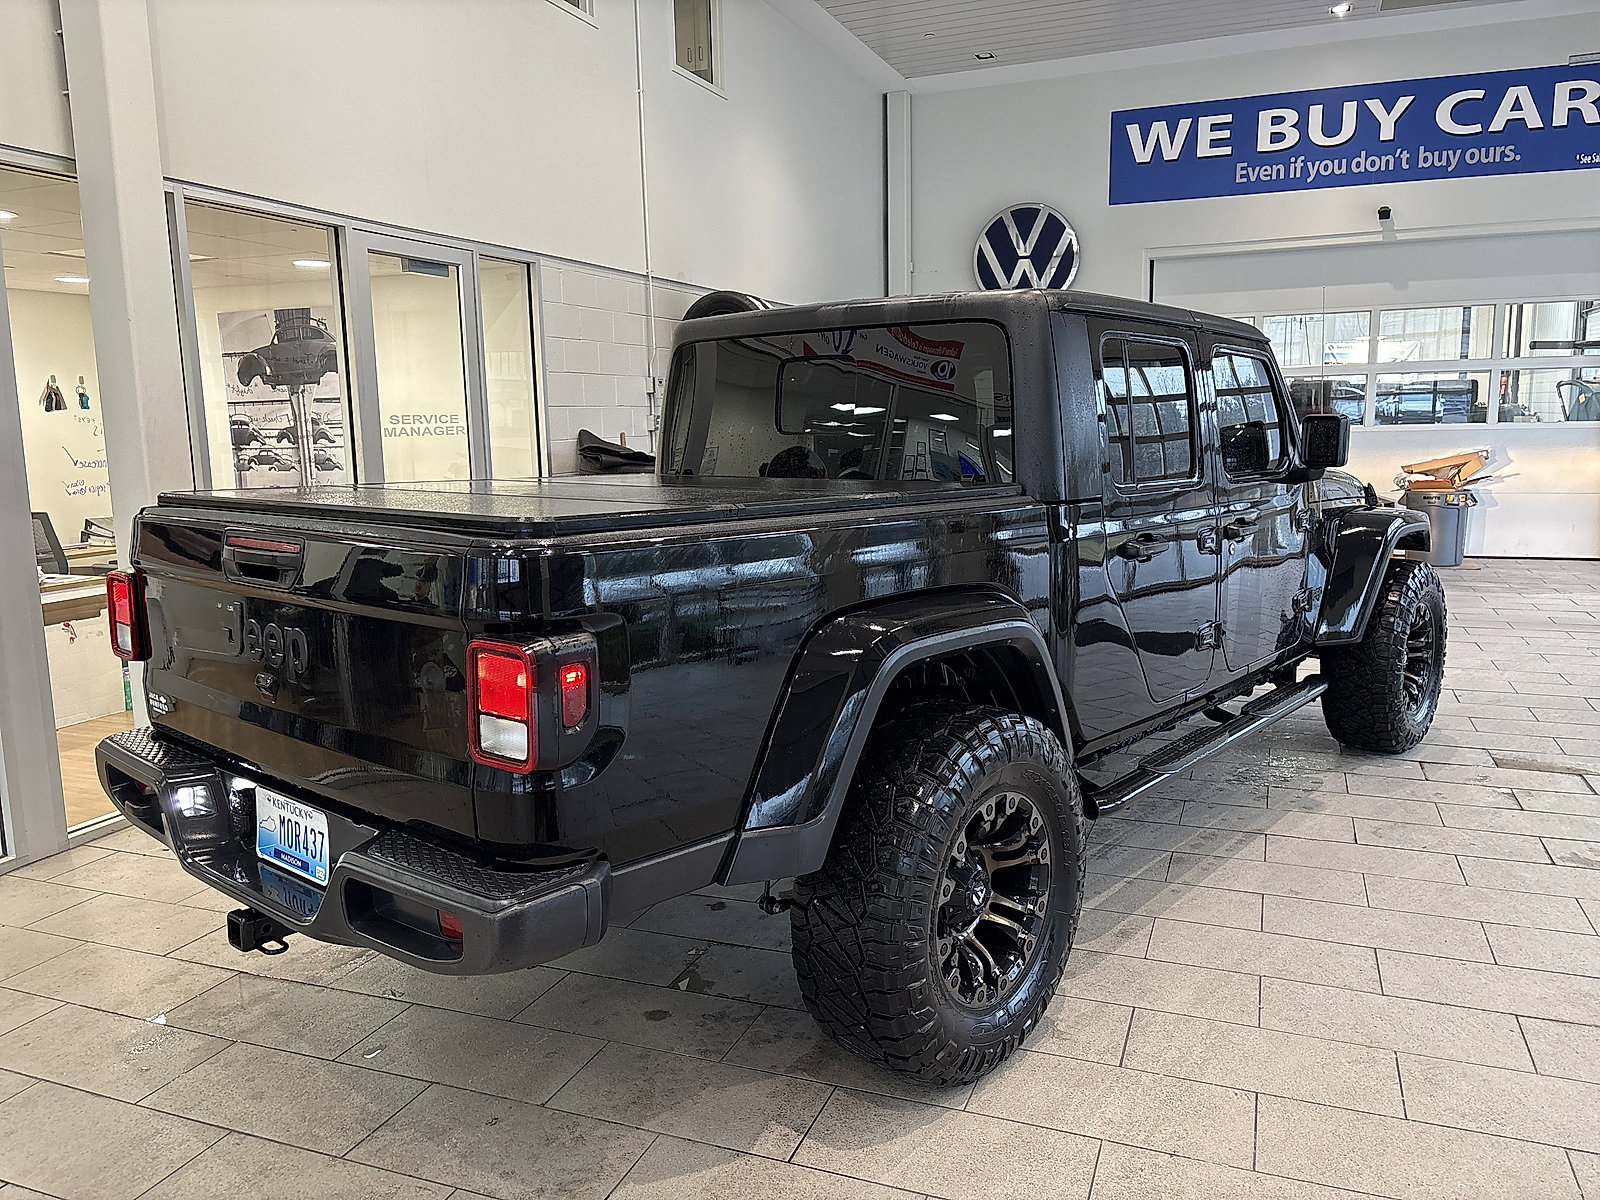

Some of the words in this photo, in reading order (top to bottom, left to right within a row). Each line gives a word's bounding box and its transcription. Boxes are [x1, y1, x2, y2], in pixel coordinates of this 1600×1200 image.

[1125, 114, 1233, 163] WE
[1257, 96, 1416, 153] BUY
[1235, 162, 1284, 183] Even
[1289, 156, 1305, 179] if
[1306, 158, 1347, 183] you
[1351, 149, 1411, 173] don't
[1418, 146, 1462, 172] buy
[1465, 145, 1521, 165] ours.
[383, 425, 466, 437] MANAGER
[389, 414, 459, 424] SERVICE
[222, 601, 309, 684] Jeep
[272, 796, 309, 820] KENTUCKY
[279, 814, 325, 862] MOR437
[280, 852, 302, 868] MADISON
